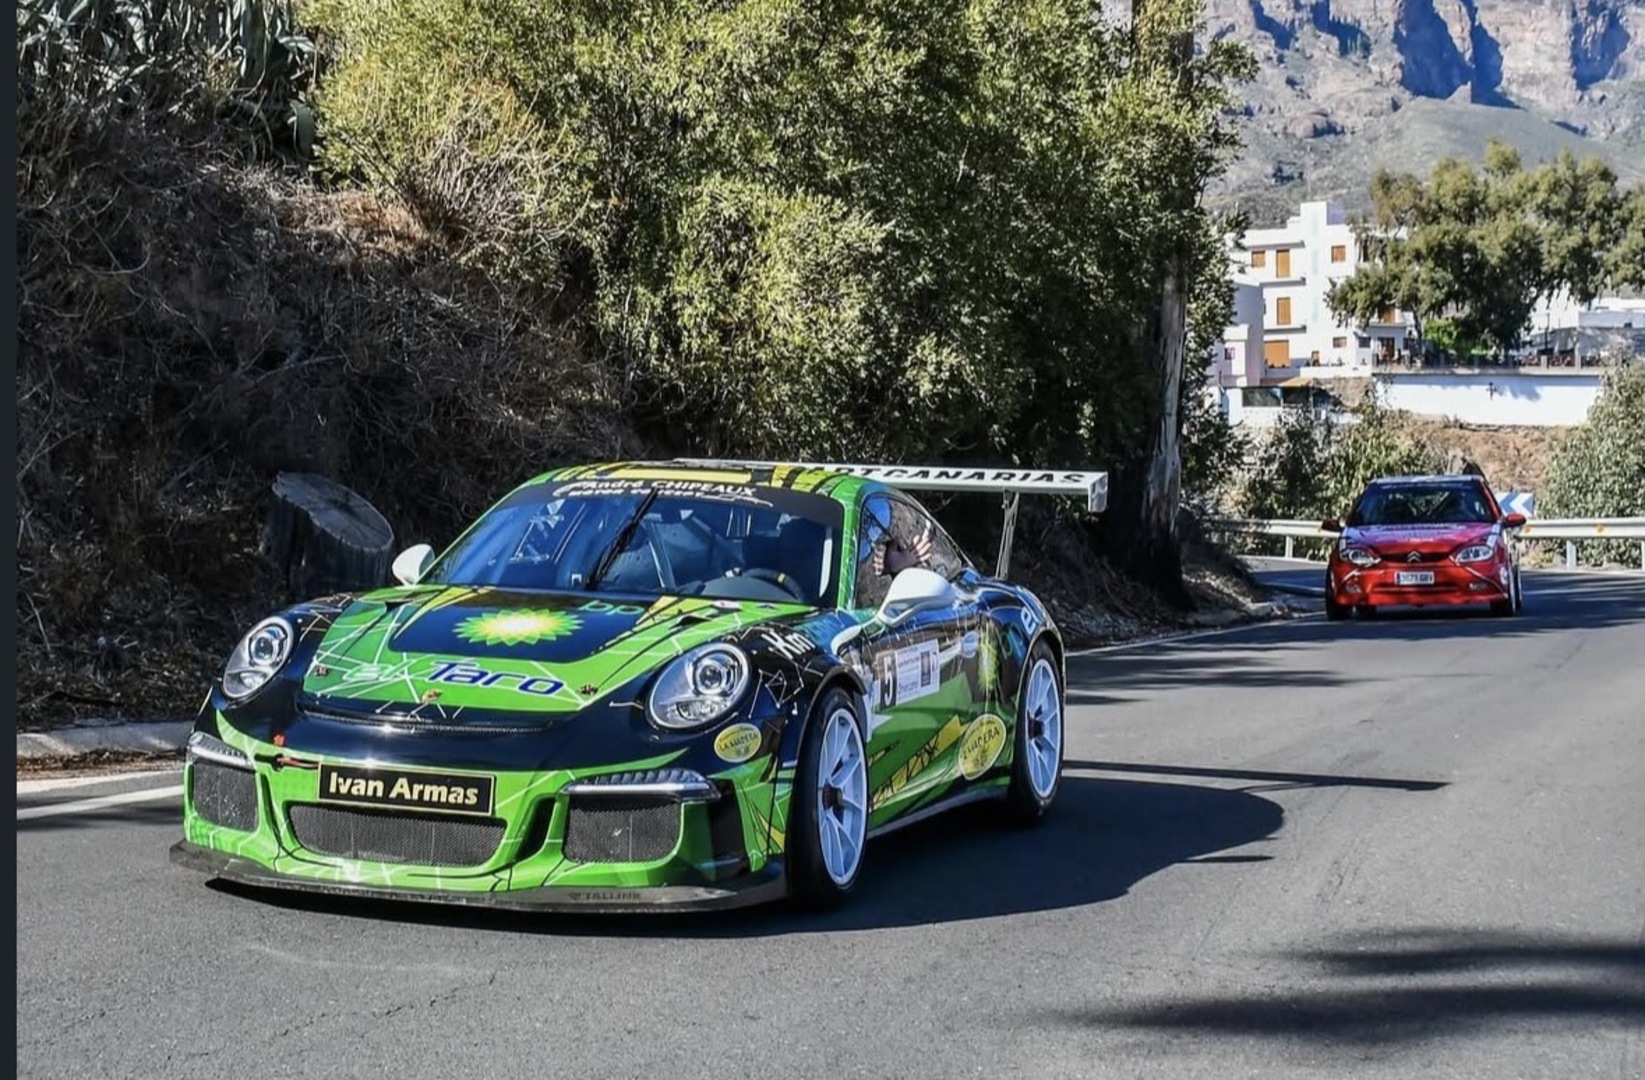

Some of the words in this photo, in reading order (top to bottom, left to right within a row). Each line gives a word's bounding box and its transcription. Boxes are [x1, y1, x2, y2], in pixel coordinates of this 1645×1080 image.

[585, 480, 644, 489] André
[651, 480, 757, 496] CHIPEAUX
[577, 599, 645, 616] bp
[426, 659, 565, 696] Taro
[883, 655, 893, 707] 5
[328, 771, 385, 798] Ivan
[388, 777, 479, 805] Armas
